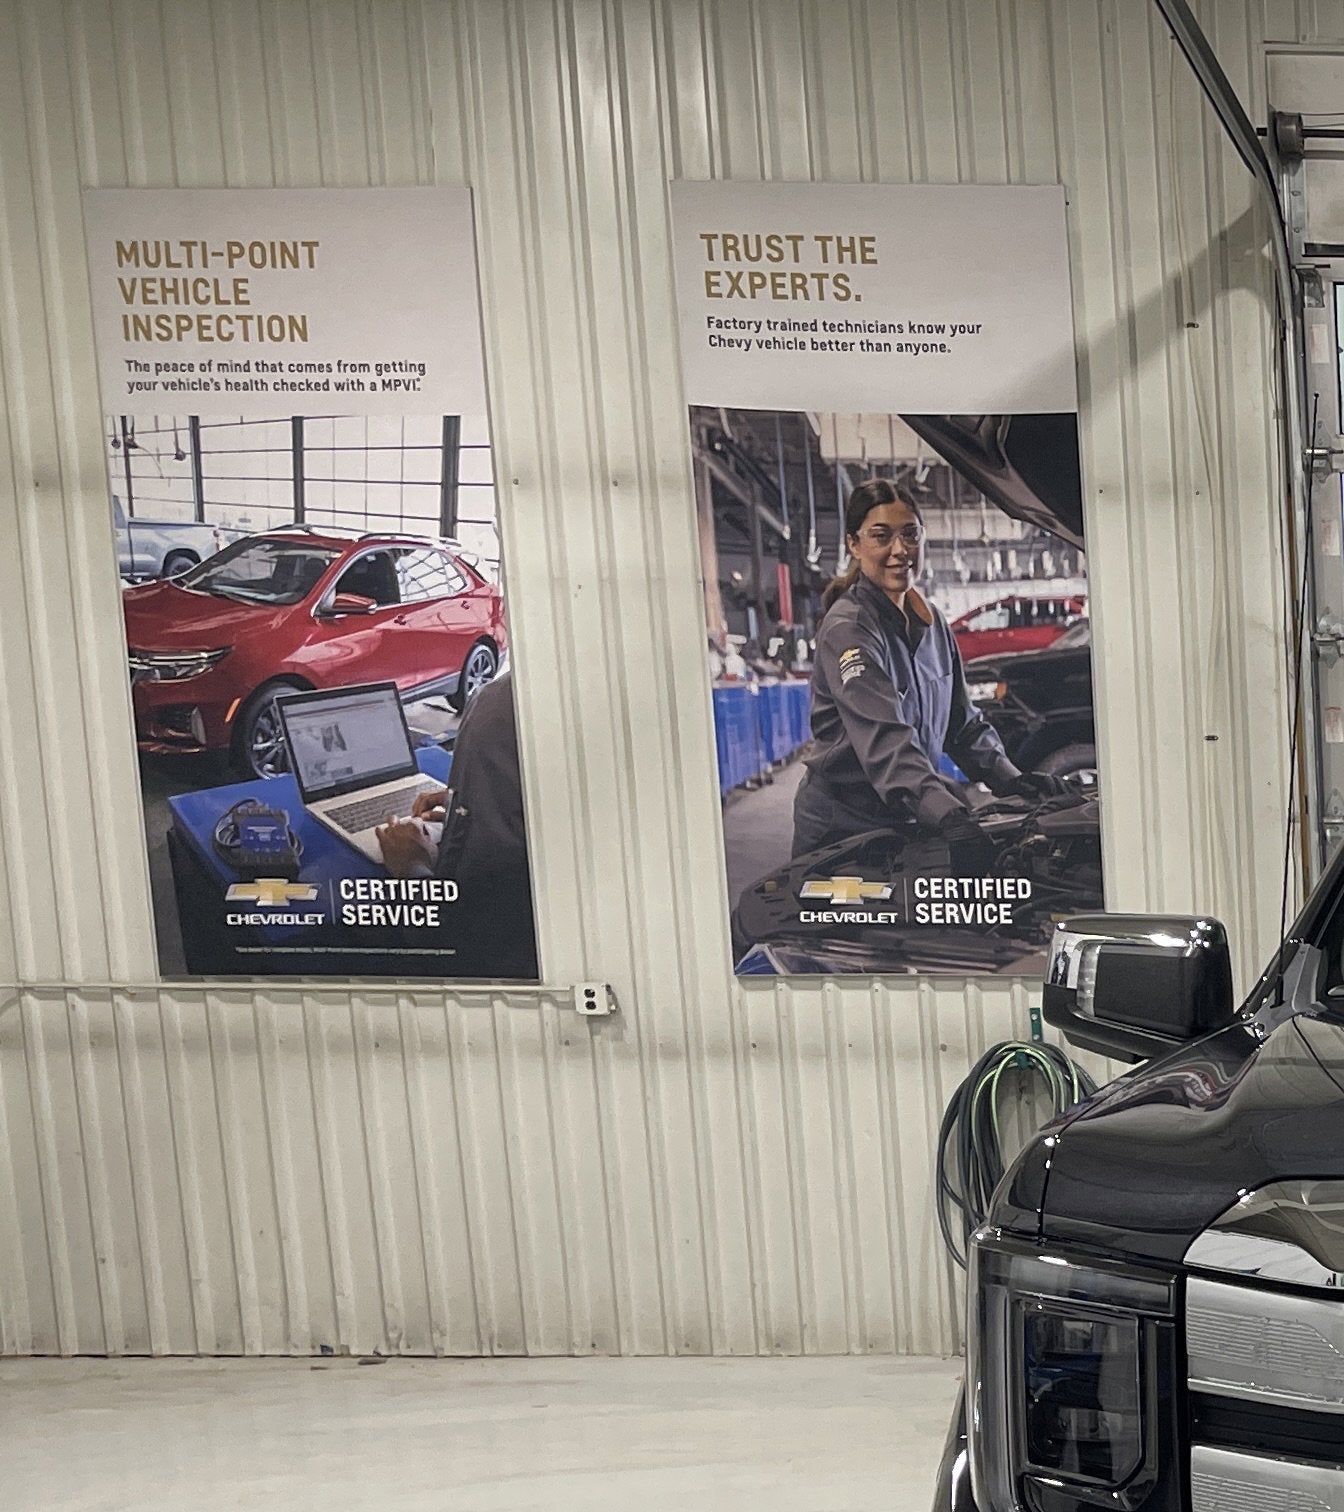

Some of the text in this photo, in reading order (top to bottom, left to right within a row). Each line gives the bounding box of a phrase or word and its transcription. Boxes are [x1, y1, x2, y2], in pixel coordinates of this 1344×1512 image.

[115, 240, 320, 269] MULTI-POINT
[700, 234, 878, 264] TRUST THE
[117, 277, 251, 306] VEHICLE
[704, 271, 862, 301] EXPERTS.
[122, 314, 309, 343] INSPECTION
[707, 316, 982, 337] Factory trained technicians know your
[708, 335, 952, 356] Chevy vehicle better than anyone.
[125, 359, 426, 376] The peace of mind that comes from getting
[127, 380, 158, 394] your
[162, 377, 221, 392] vehicle's
[225, 378, 269, 391] health
[273, 378, 330, 392] checked
[334, 378, 365, 391] with
[370, 380, 377, 391] a
[340, 879, 459, 902] CERTIFIED
[914, 878, 1032, 900] CERTIFIED
[226, 912, 325, 926] CHEVROLET
[342, 905, 441, 927] SERVICE
[800, 910, 898, 924] CHEVROLET
[915, 904, 1013, 925] SERVICE
